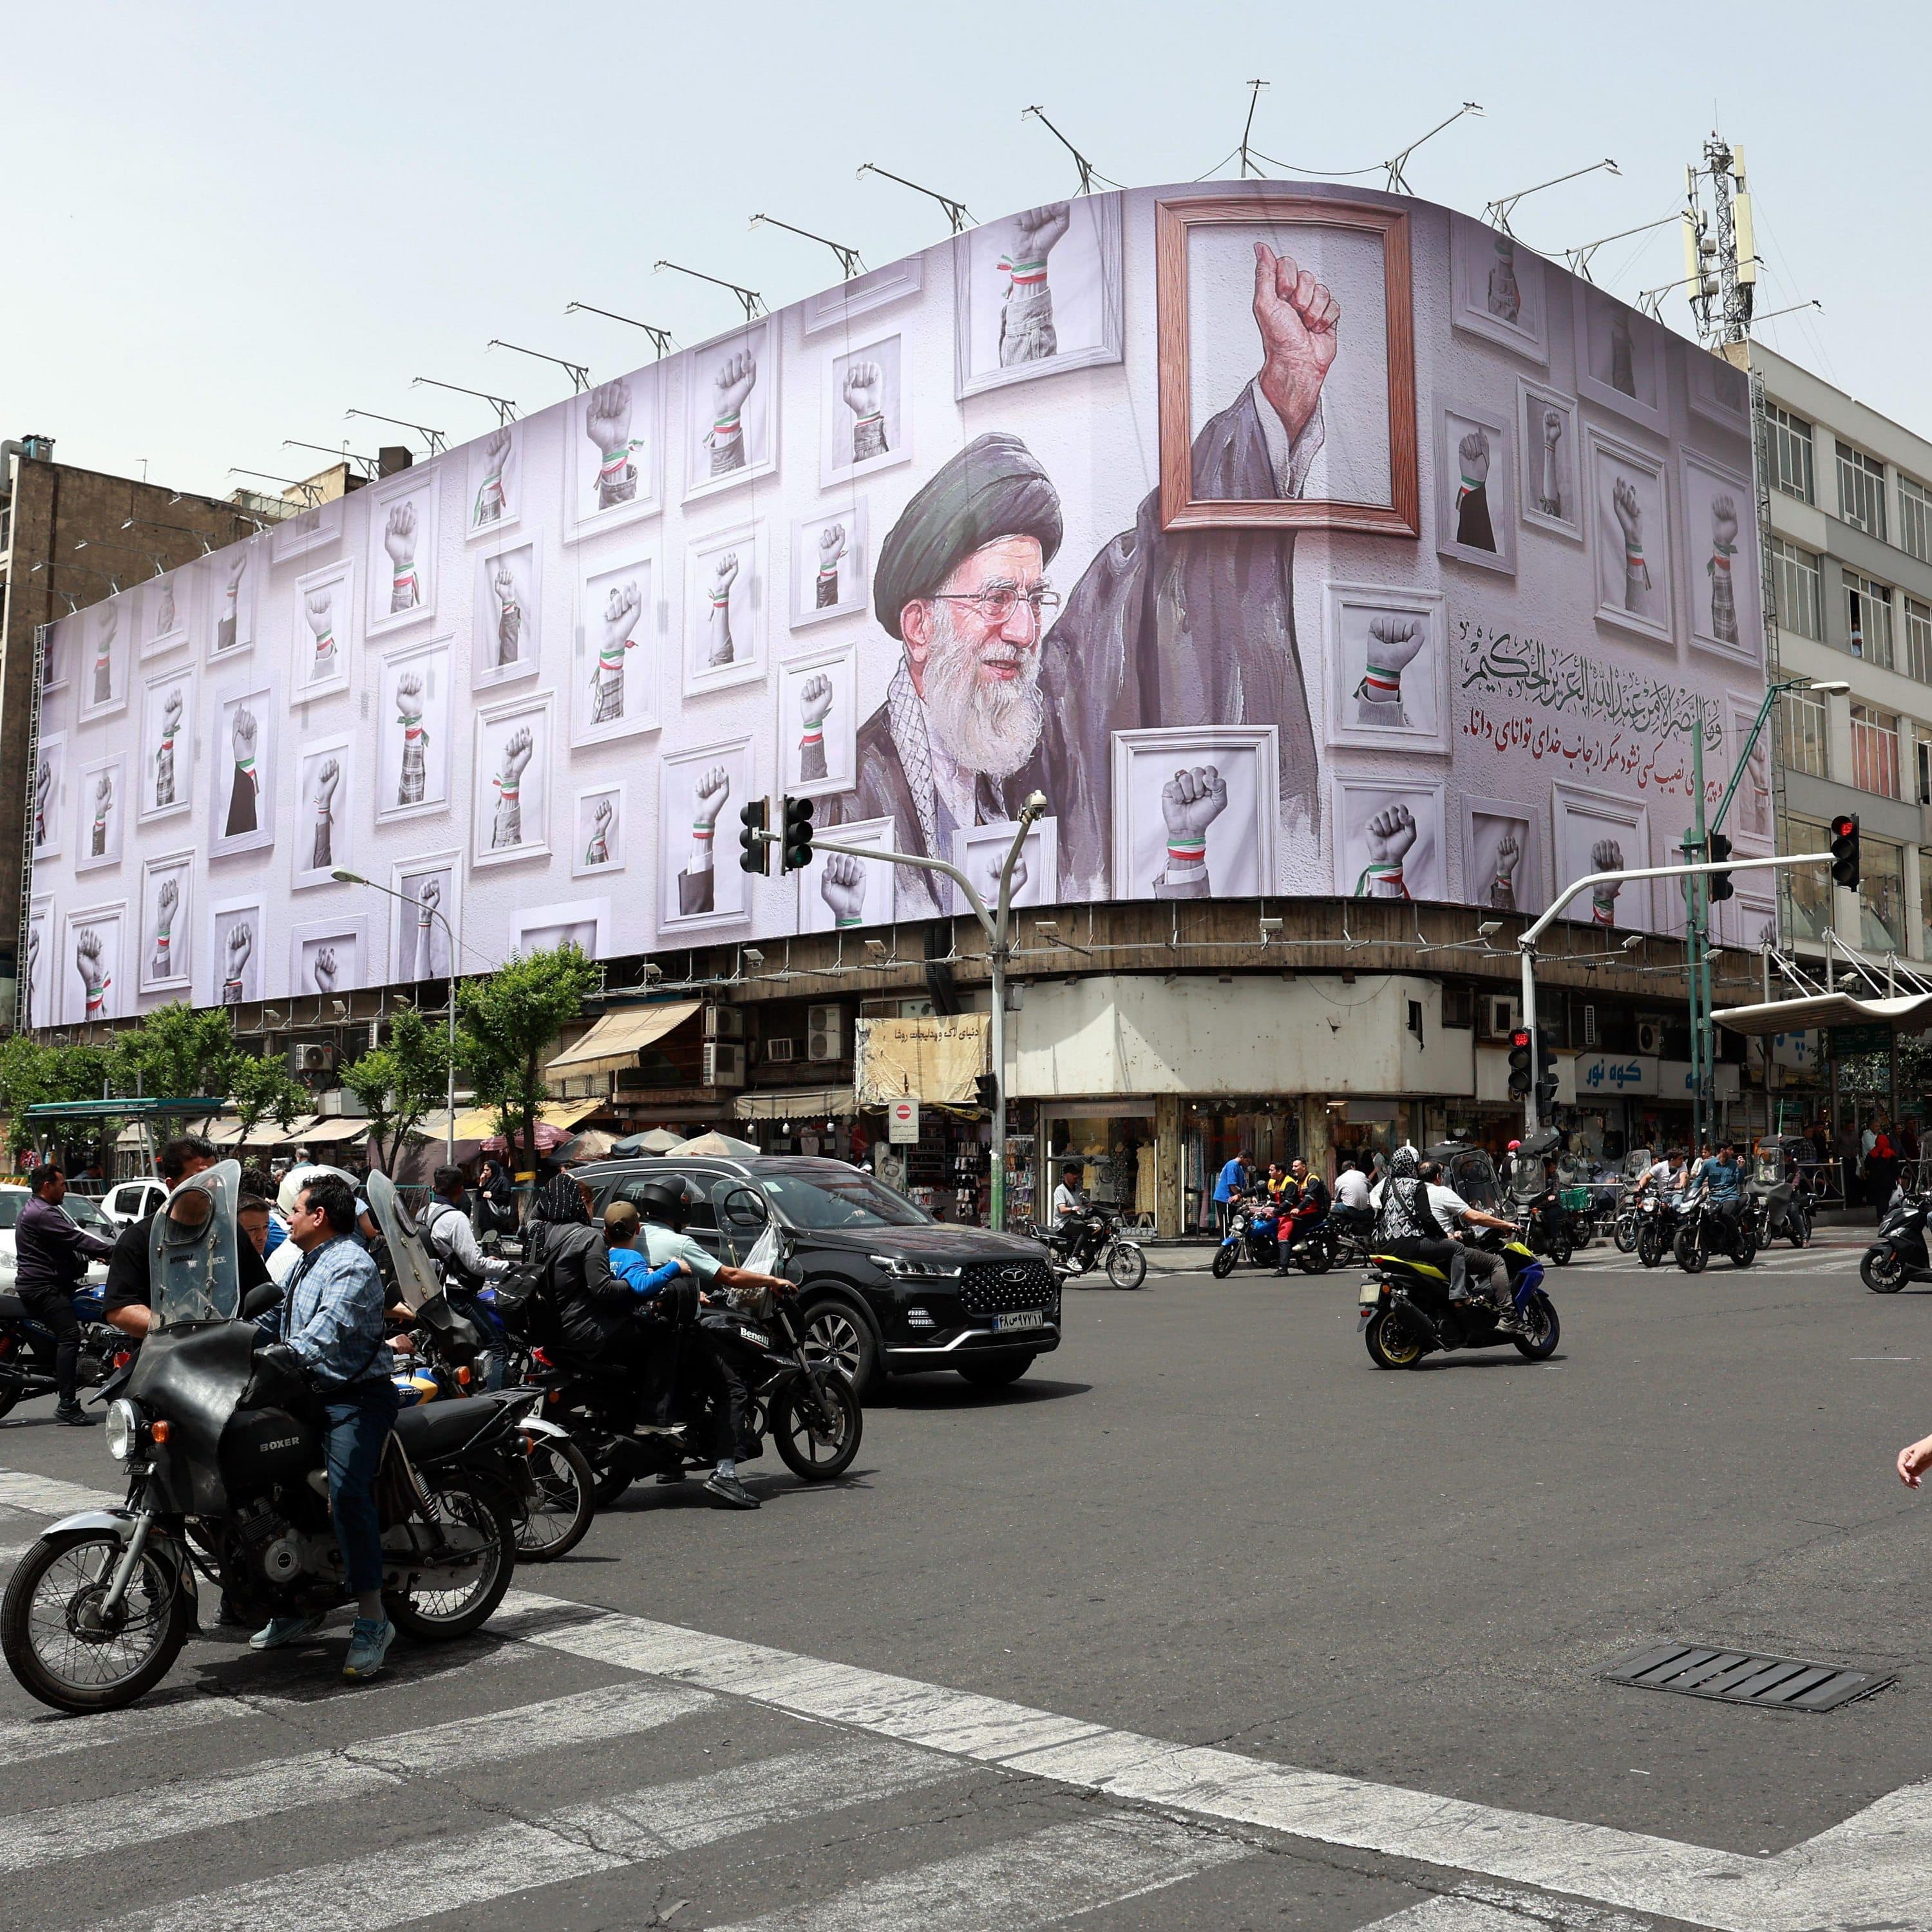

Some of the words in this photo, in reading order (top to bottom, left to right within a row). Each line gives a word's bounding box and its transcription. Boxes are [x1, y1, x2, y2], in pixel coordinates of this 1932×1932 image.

[1495, 716, 1533, 752] توانای
[1532, 724, 1562, 760] خدای
[1563, 735, 1593, 776] جانب
[1592, 741, 1603, 767] از
[1602, 733, 1621, 772] مگر
[1620, 744, 1640, 775] نشود
[1637, 741, 1664, 789] کسی
[1654, 758, 1684, 794] نصیب
[1718, 783, 1723, 797] و
[958, 1027, 979, 1041] دنیای
[1586, 1058, 1605, 1088] نور
[1609, 1059, 1642, 1089] کوه
[741, 1327, 770, 1346] Benelli
[260, 1437, 299, 1452] BOXER
